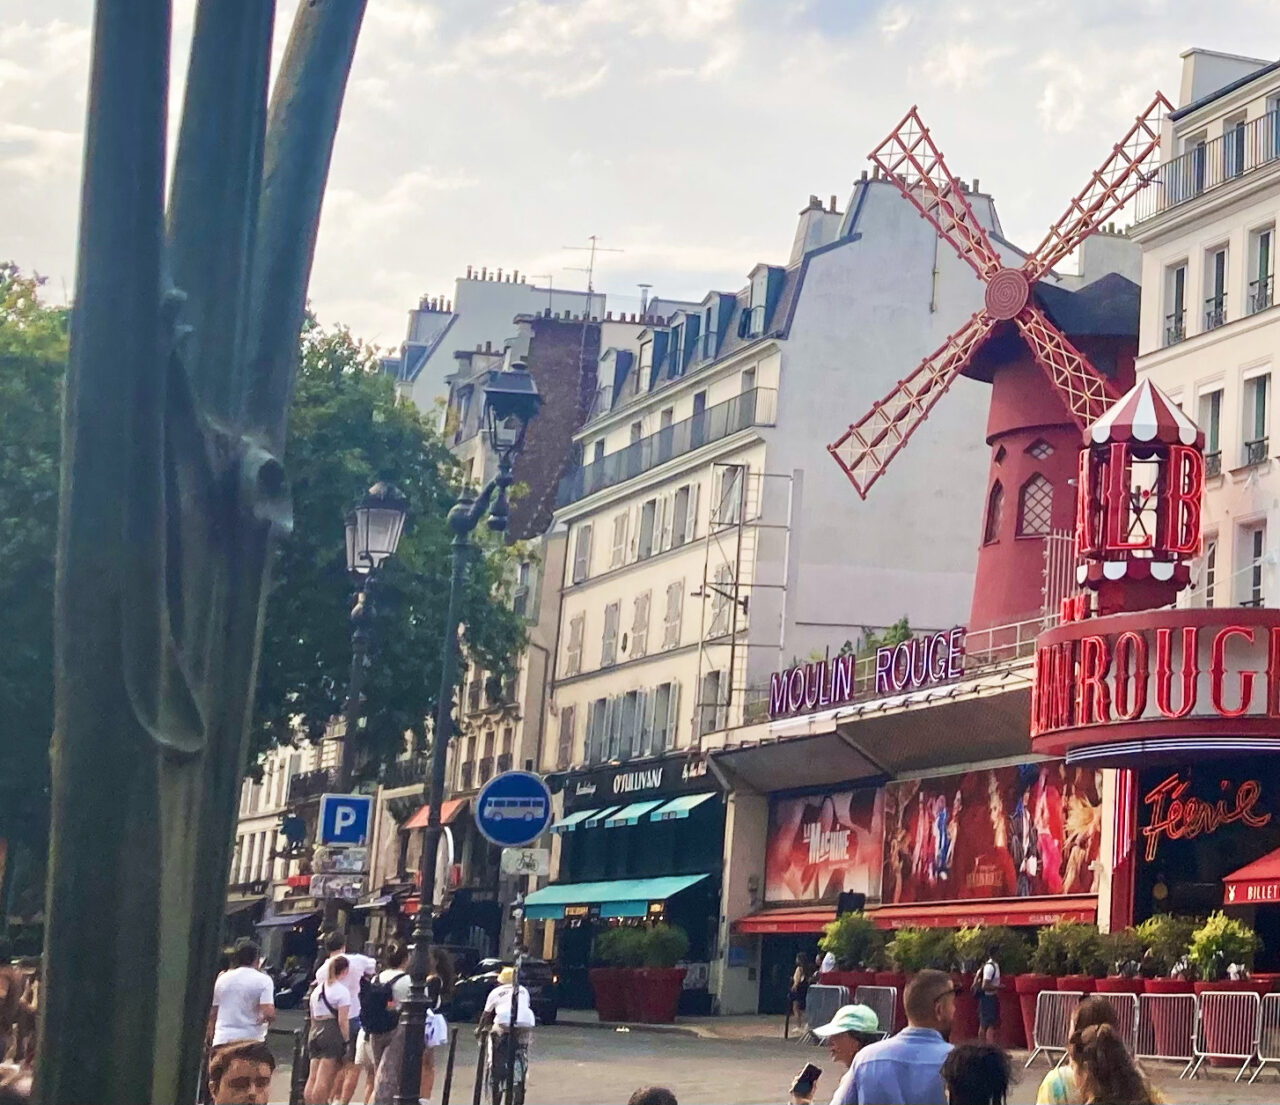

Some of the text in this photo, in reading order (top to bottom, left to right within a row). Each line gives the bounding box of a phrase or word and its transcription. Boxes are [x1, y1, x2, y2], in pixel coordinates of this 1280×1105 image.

[769, 627, 967, 715] MOULIN ROUGE
[334, 806, 356, 835] P
